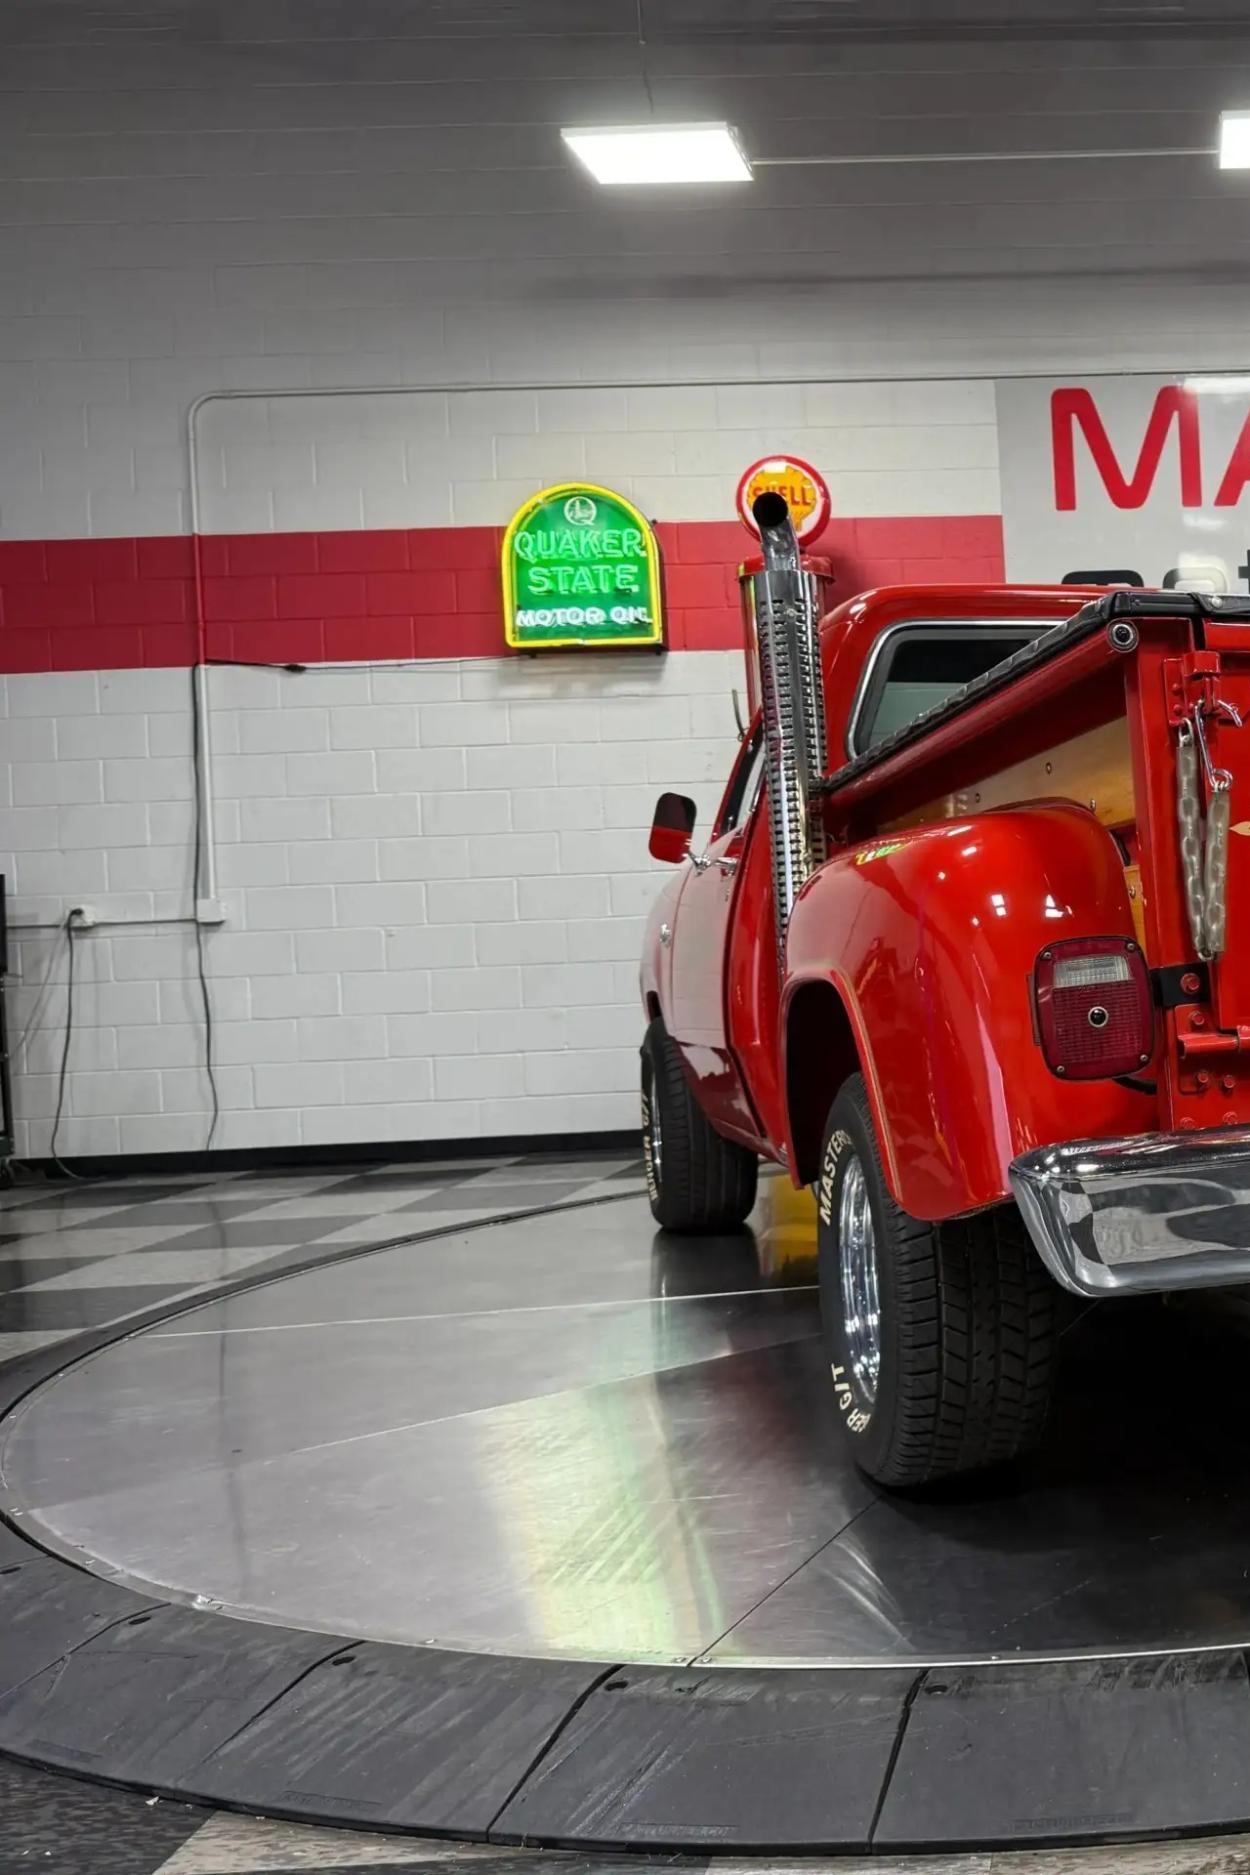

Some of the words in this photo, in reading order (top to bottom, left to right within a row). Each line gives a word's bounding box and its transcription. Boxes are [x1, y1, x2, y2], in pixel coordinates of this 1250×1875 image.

[514, 528, 647, 564] QUAKER
[527, 564, 640, 595] STATE
[516, 606, 607, 628] MOTOR
[610, 606, 653, 625] OIL
